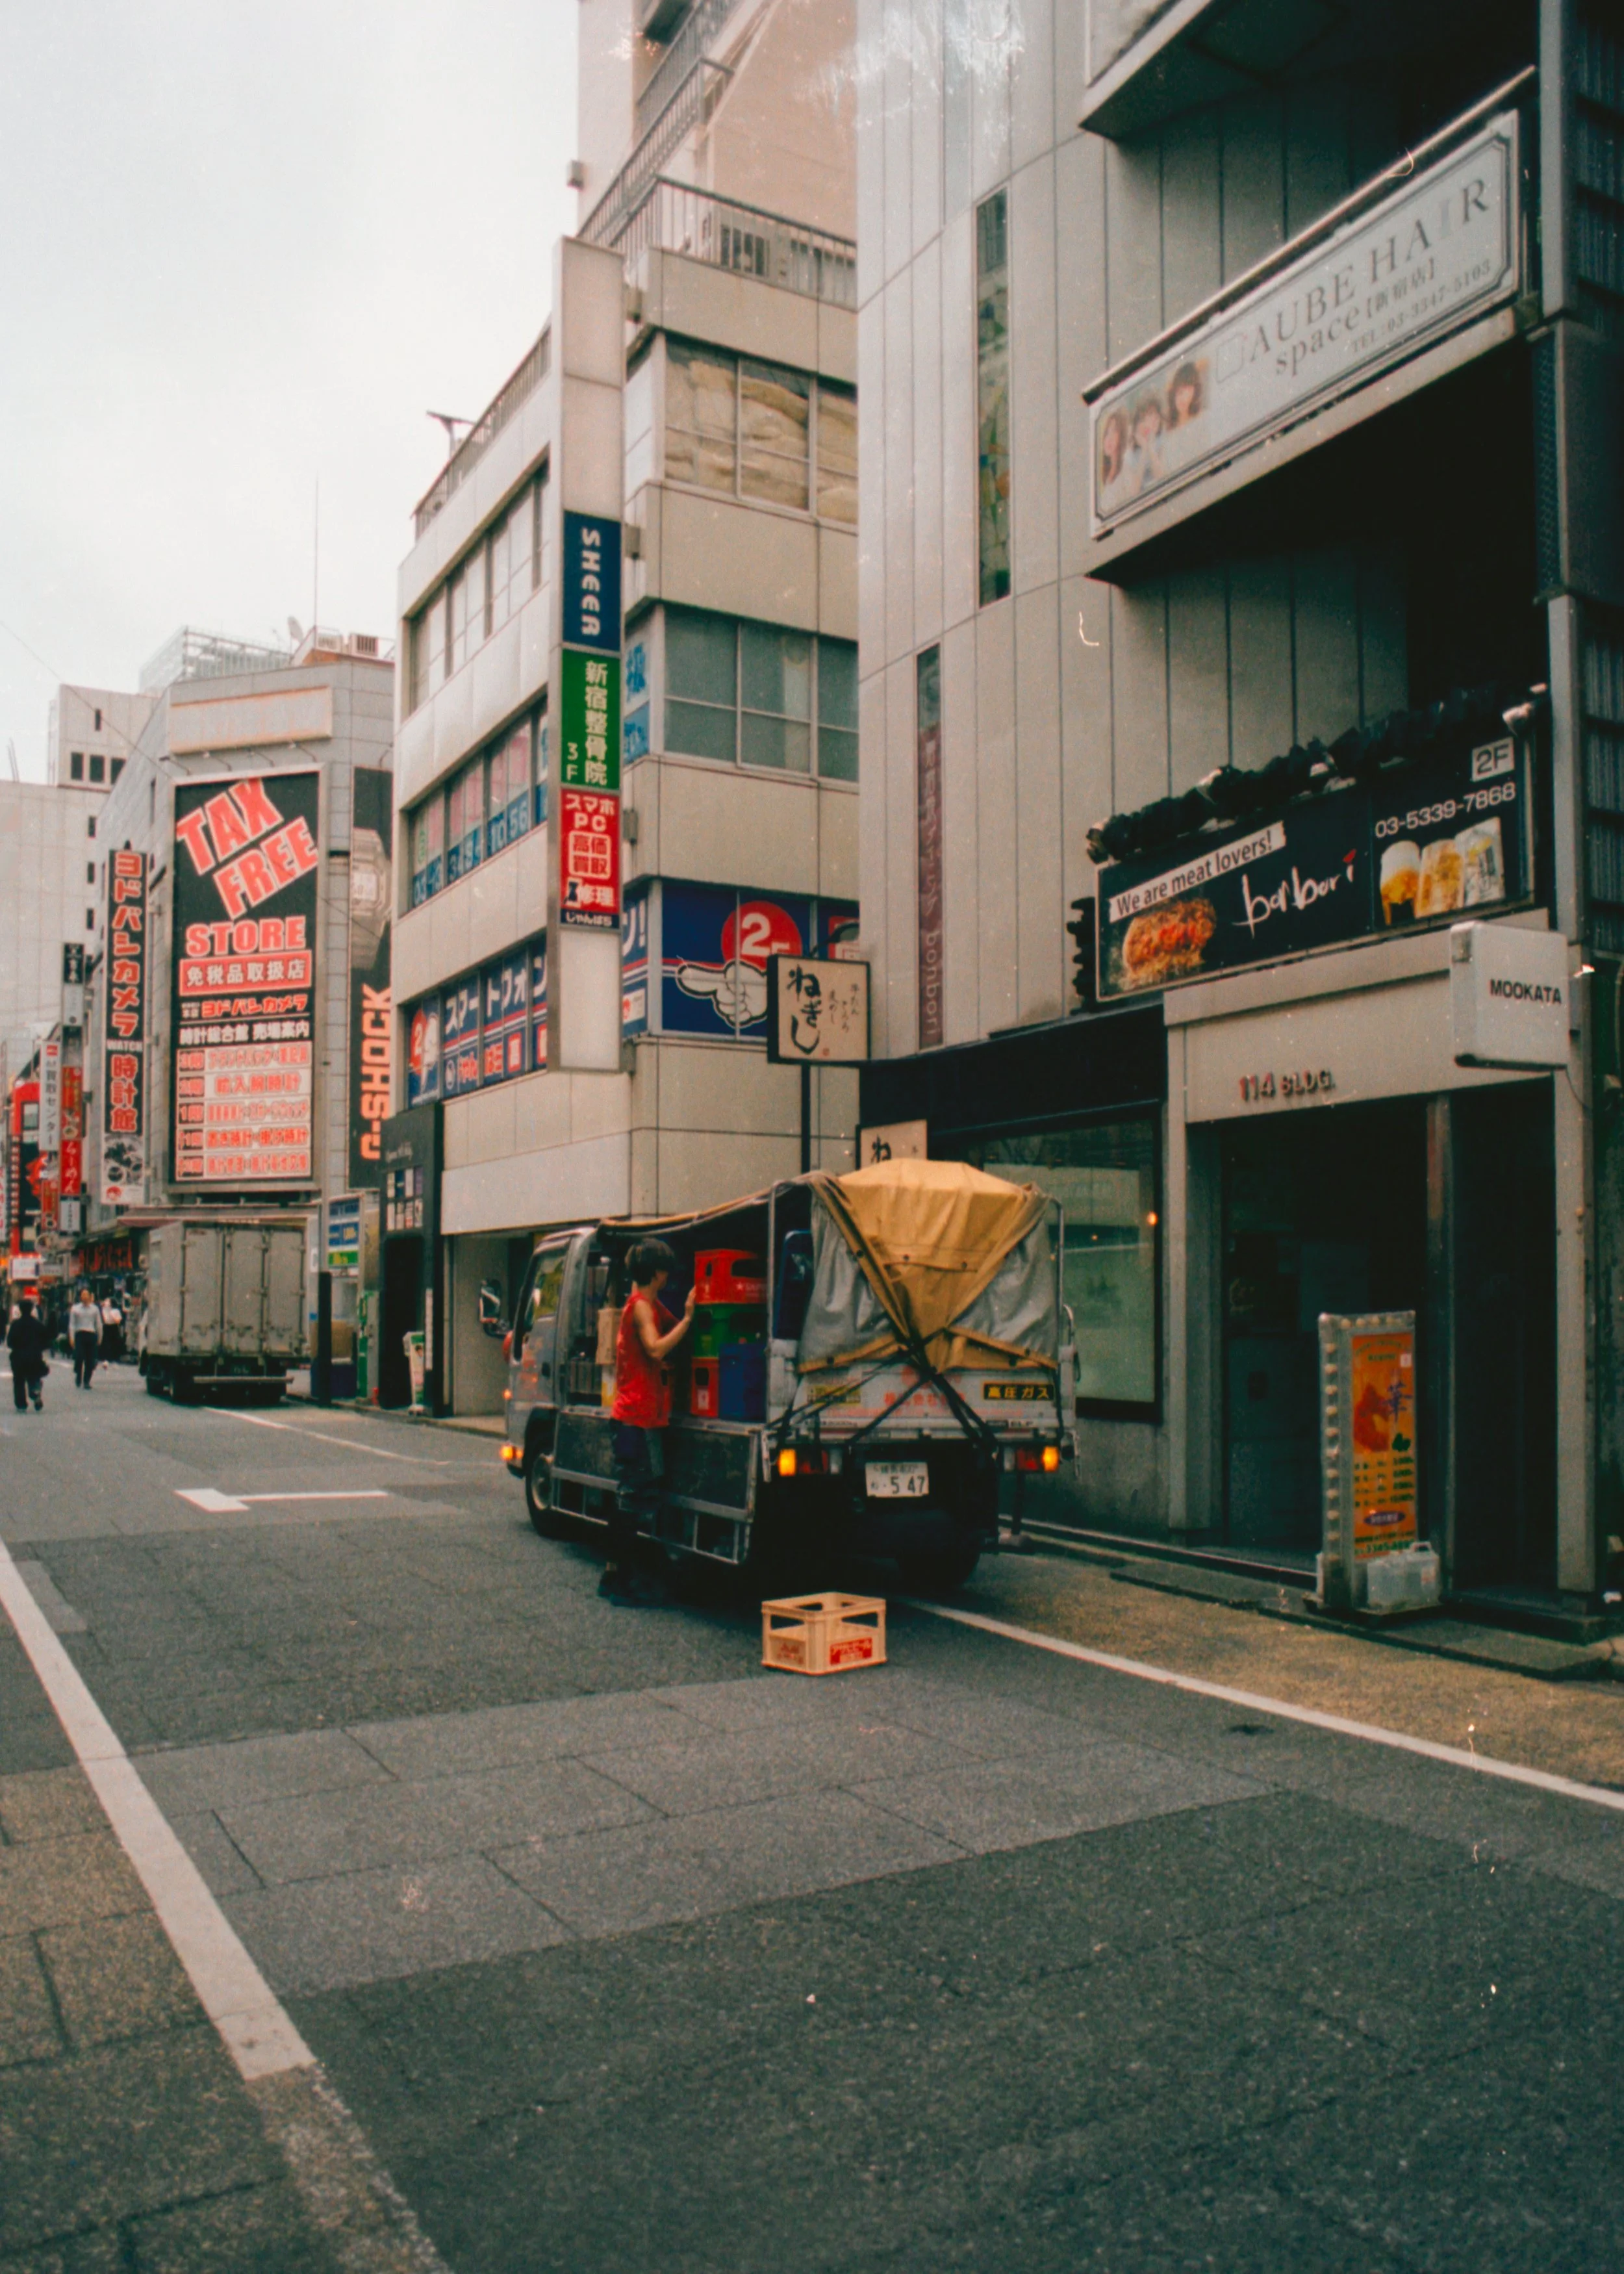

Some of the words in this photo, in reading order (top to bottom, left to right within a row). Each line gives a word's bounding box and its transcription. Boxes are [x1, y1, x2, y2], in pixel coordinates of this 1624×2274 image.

[1250, 264, 1356, 363] AUBE
[1371, 179, 1489, 284] HAIR
[1275, 305, 1360, 377] space
[1476, 743, 1510, 775] 2F
[176, 776, 285, 876] TAX
[565, 793, 615, 815] スマホ
[574, 812, 607, 832] PC
[1374, 780, 1517, 839] 03-5339-7868
[212, 815, 320, 921] FREE
[1117, 891, 1140, 917] We
[1144, 882, 1168, 904] are
[1171, 860, 1212, 893] meat
[1215, 829, 1273, 873] lovers!
[112, 850, 143, 1037] ヨドバシカメラ
[185, 914, 307, 957] STORE
[201, 993, 309, 1018] ヨドバシカメラ
[786, 964, 822, 1056] ねぎし
[1488, 978, 1562, 1004] MOOKATA
[110, 1053, 138, 1133] 時計館
[360, 982, 390, 1160] G-SHOCK
[1239, 1071, 1276, 1102] 114
[988, 1386, 1050, 1399] 高圧ガス
